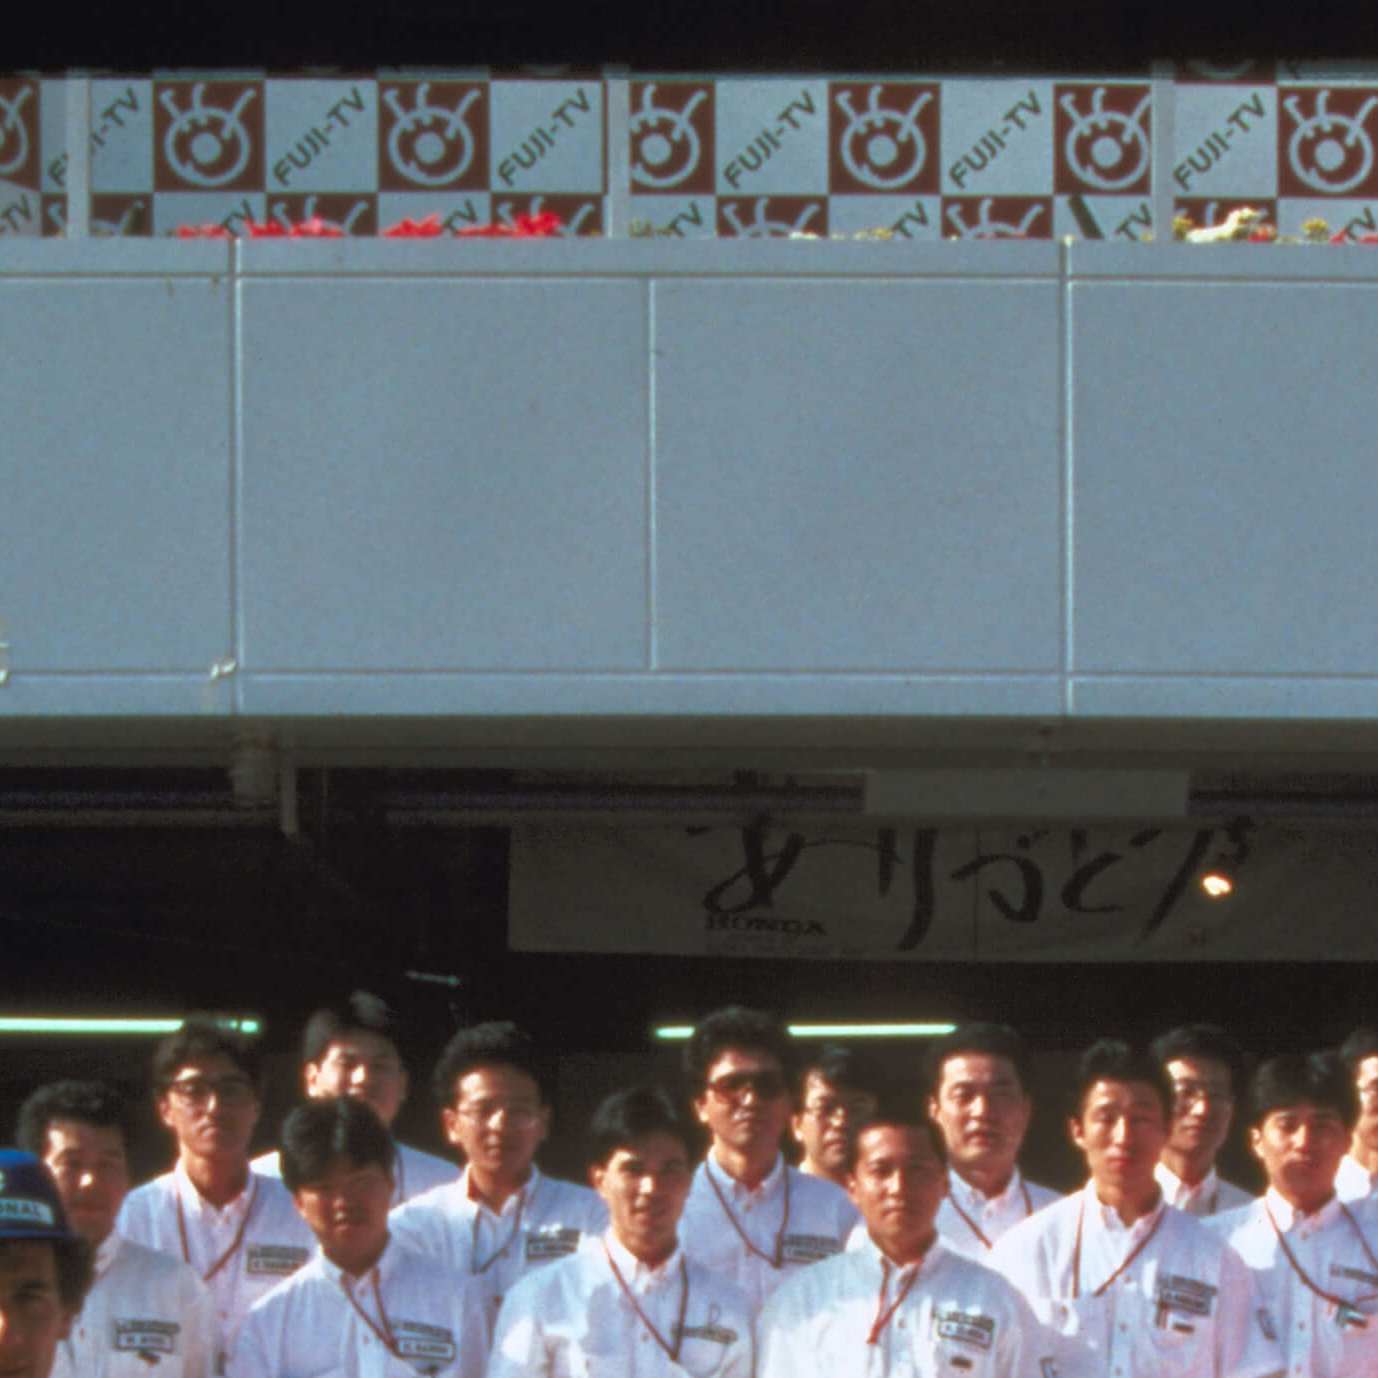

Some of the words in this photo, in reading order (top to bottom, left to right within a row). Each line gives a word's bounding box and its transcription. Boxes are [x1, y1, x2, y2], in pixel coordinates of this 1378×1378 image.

[273, 87, 366, 187] FUJI-TV
[498, 87, 591, 187] FUJI-TV
[724, 89, 818, 188] FUJI-TV
[949, 90, 1042, 189] FUJI-TV
[1173, 92, 1266, 191] FUJI-TV
